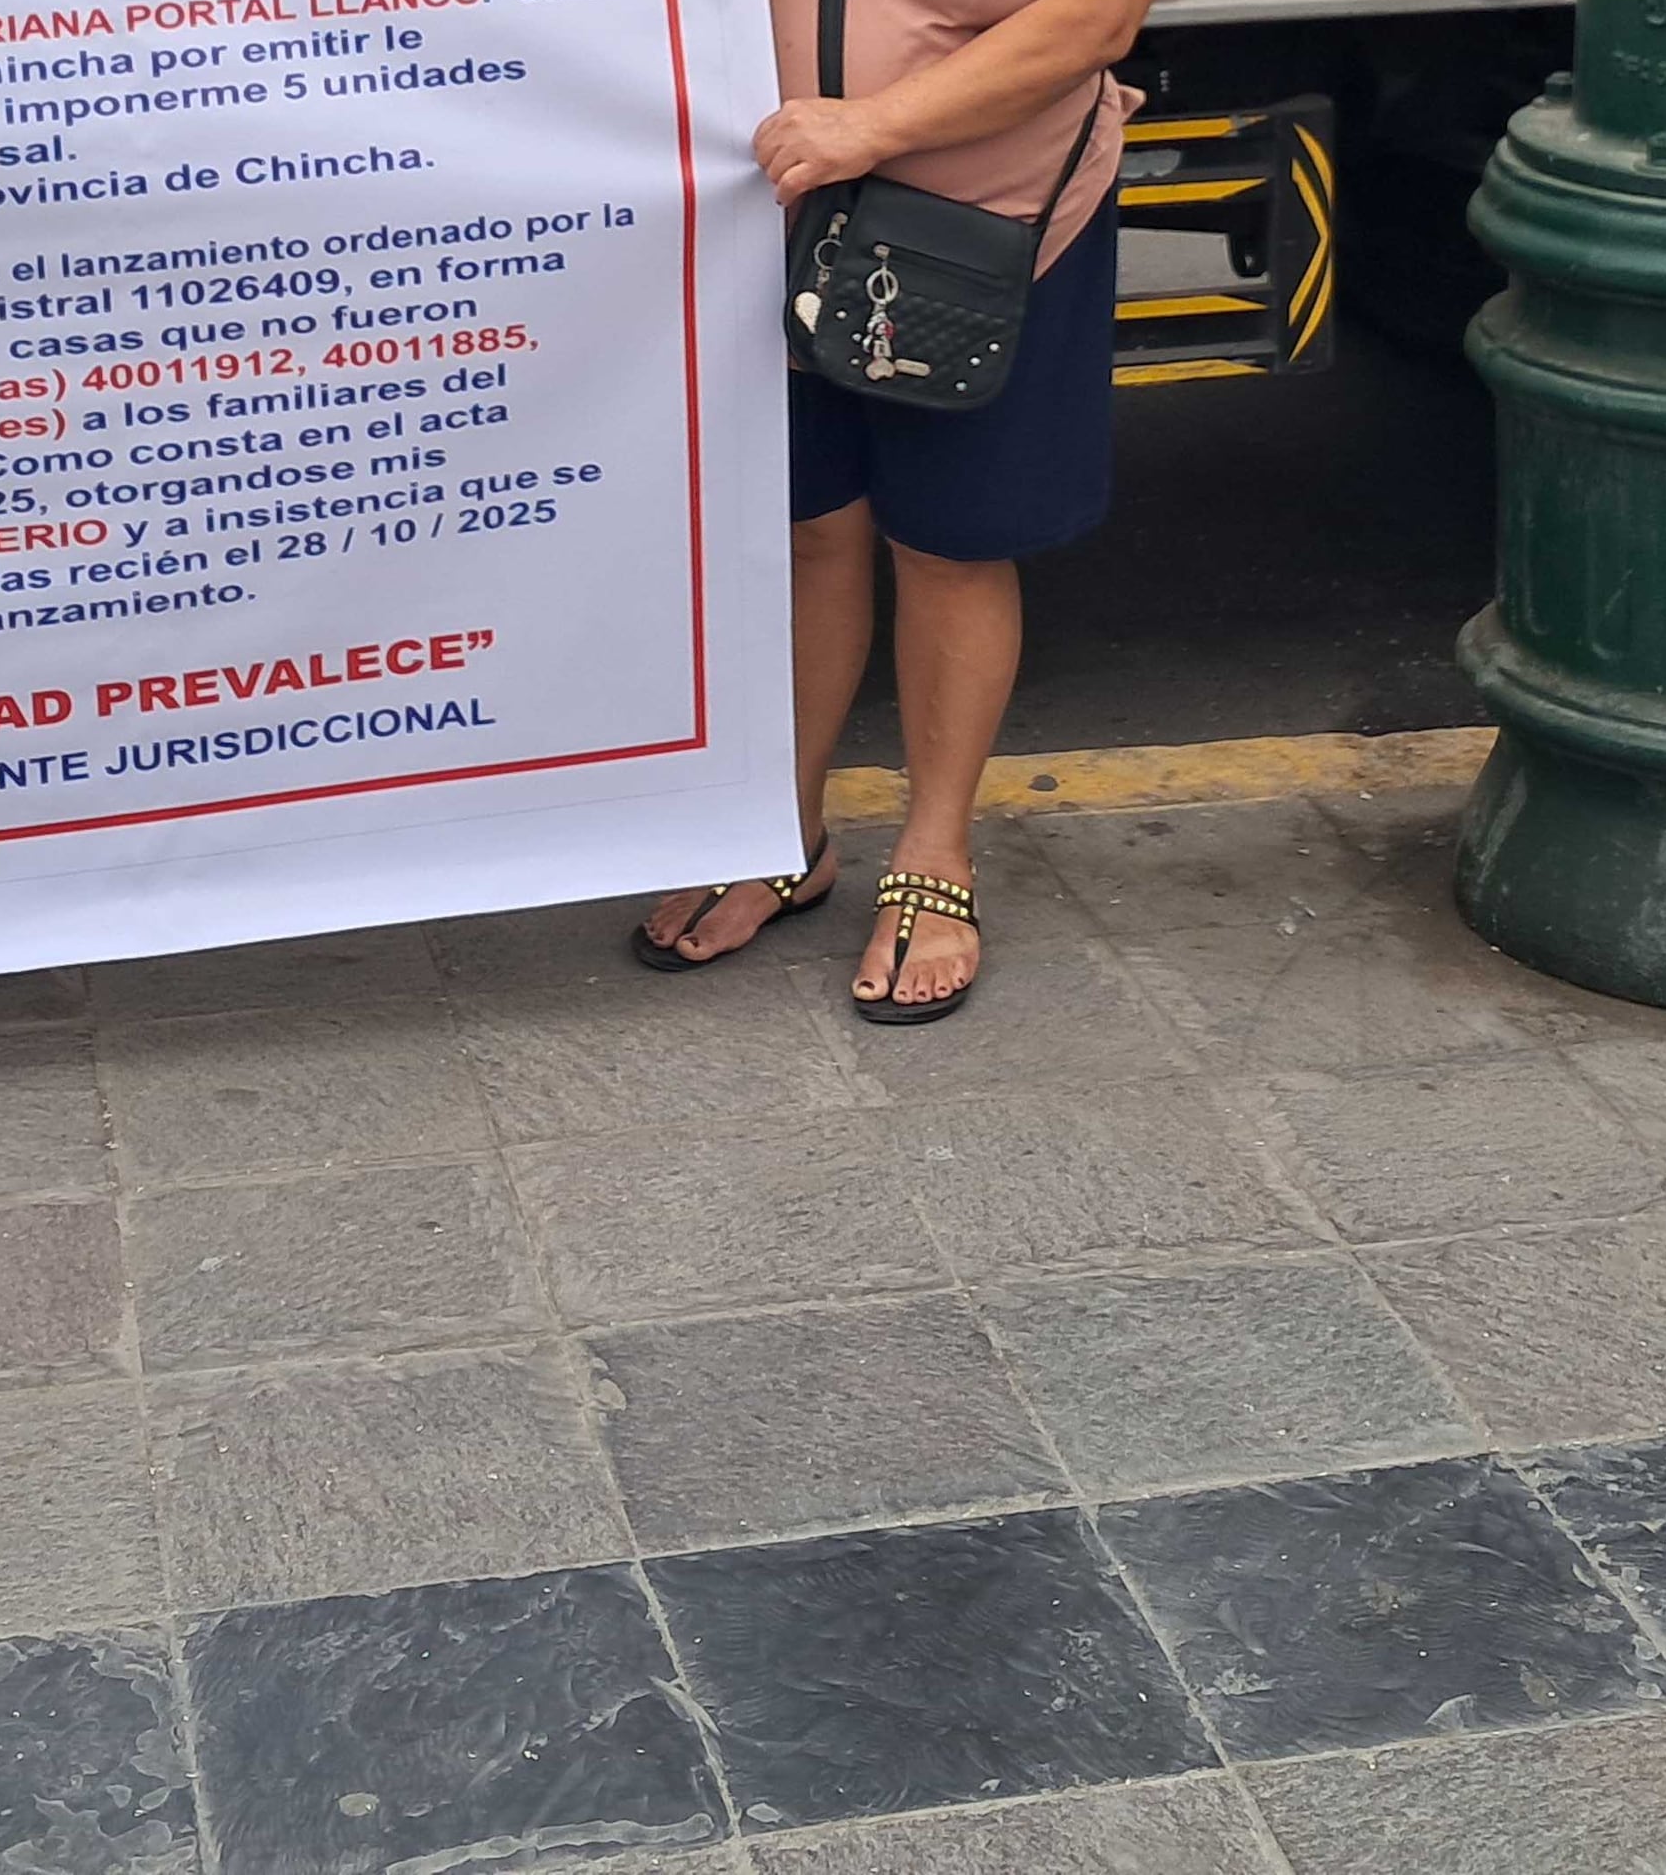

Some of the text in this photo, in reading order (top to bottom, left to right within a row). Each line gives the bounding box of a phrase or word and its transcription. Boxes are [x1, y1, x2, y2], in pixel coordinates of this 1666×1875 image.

[4, 82, 268, 127] imponerme
[283, 72, 308, 100] 5
[323, 57, 527, 97] unidades
[11, 254, 46, 282] el
[61, 235, 310, 279] lanzamiento
[323, 215, 513, 256] ordenado
[526, 211, 592, 243] por
[603, 202, 635, 229] la
[81, 348, 306, 392] 40011912,
[321, 323, 539, 369] 40011885,
[82, 411, 108, 432] a
[123, 401, 191, 427] los
[206, 378, 427, 419] familiares
[442, 362, 506, 394] del
[122, 520, 149, 549] y
[164, 516, 190, 538] a
[205, 481, 445, 533] insistencia
[459, 470, 539, 502] que
[552, 463, 602, 486] se
[104, 697, 497, 776] JURISDICCIONAL
